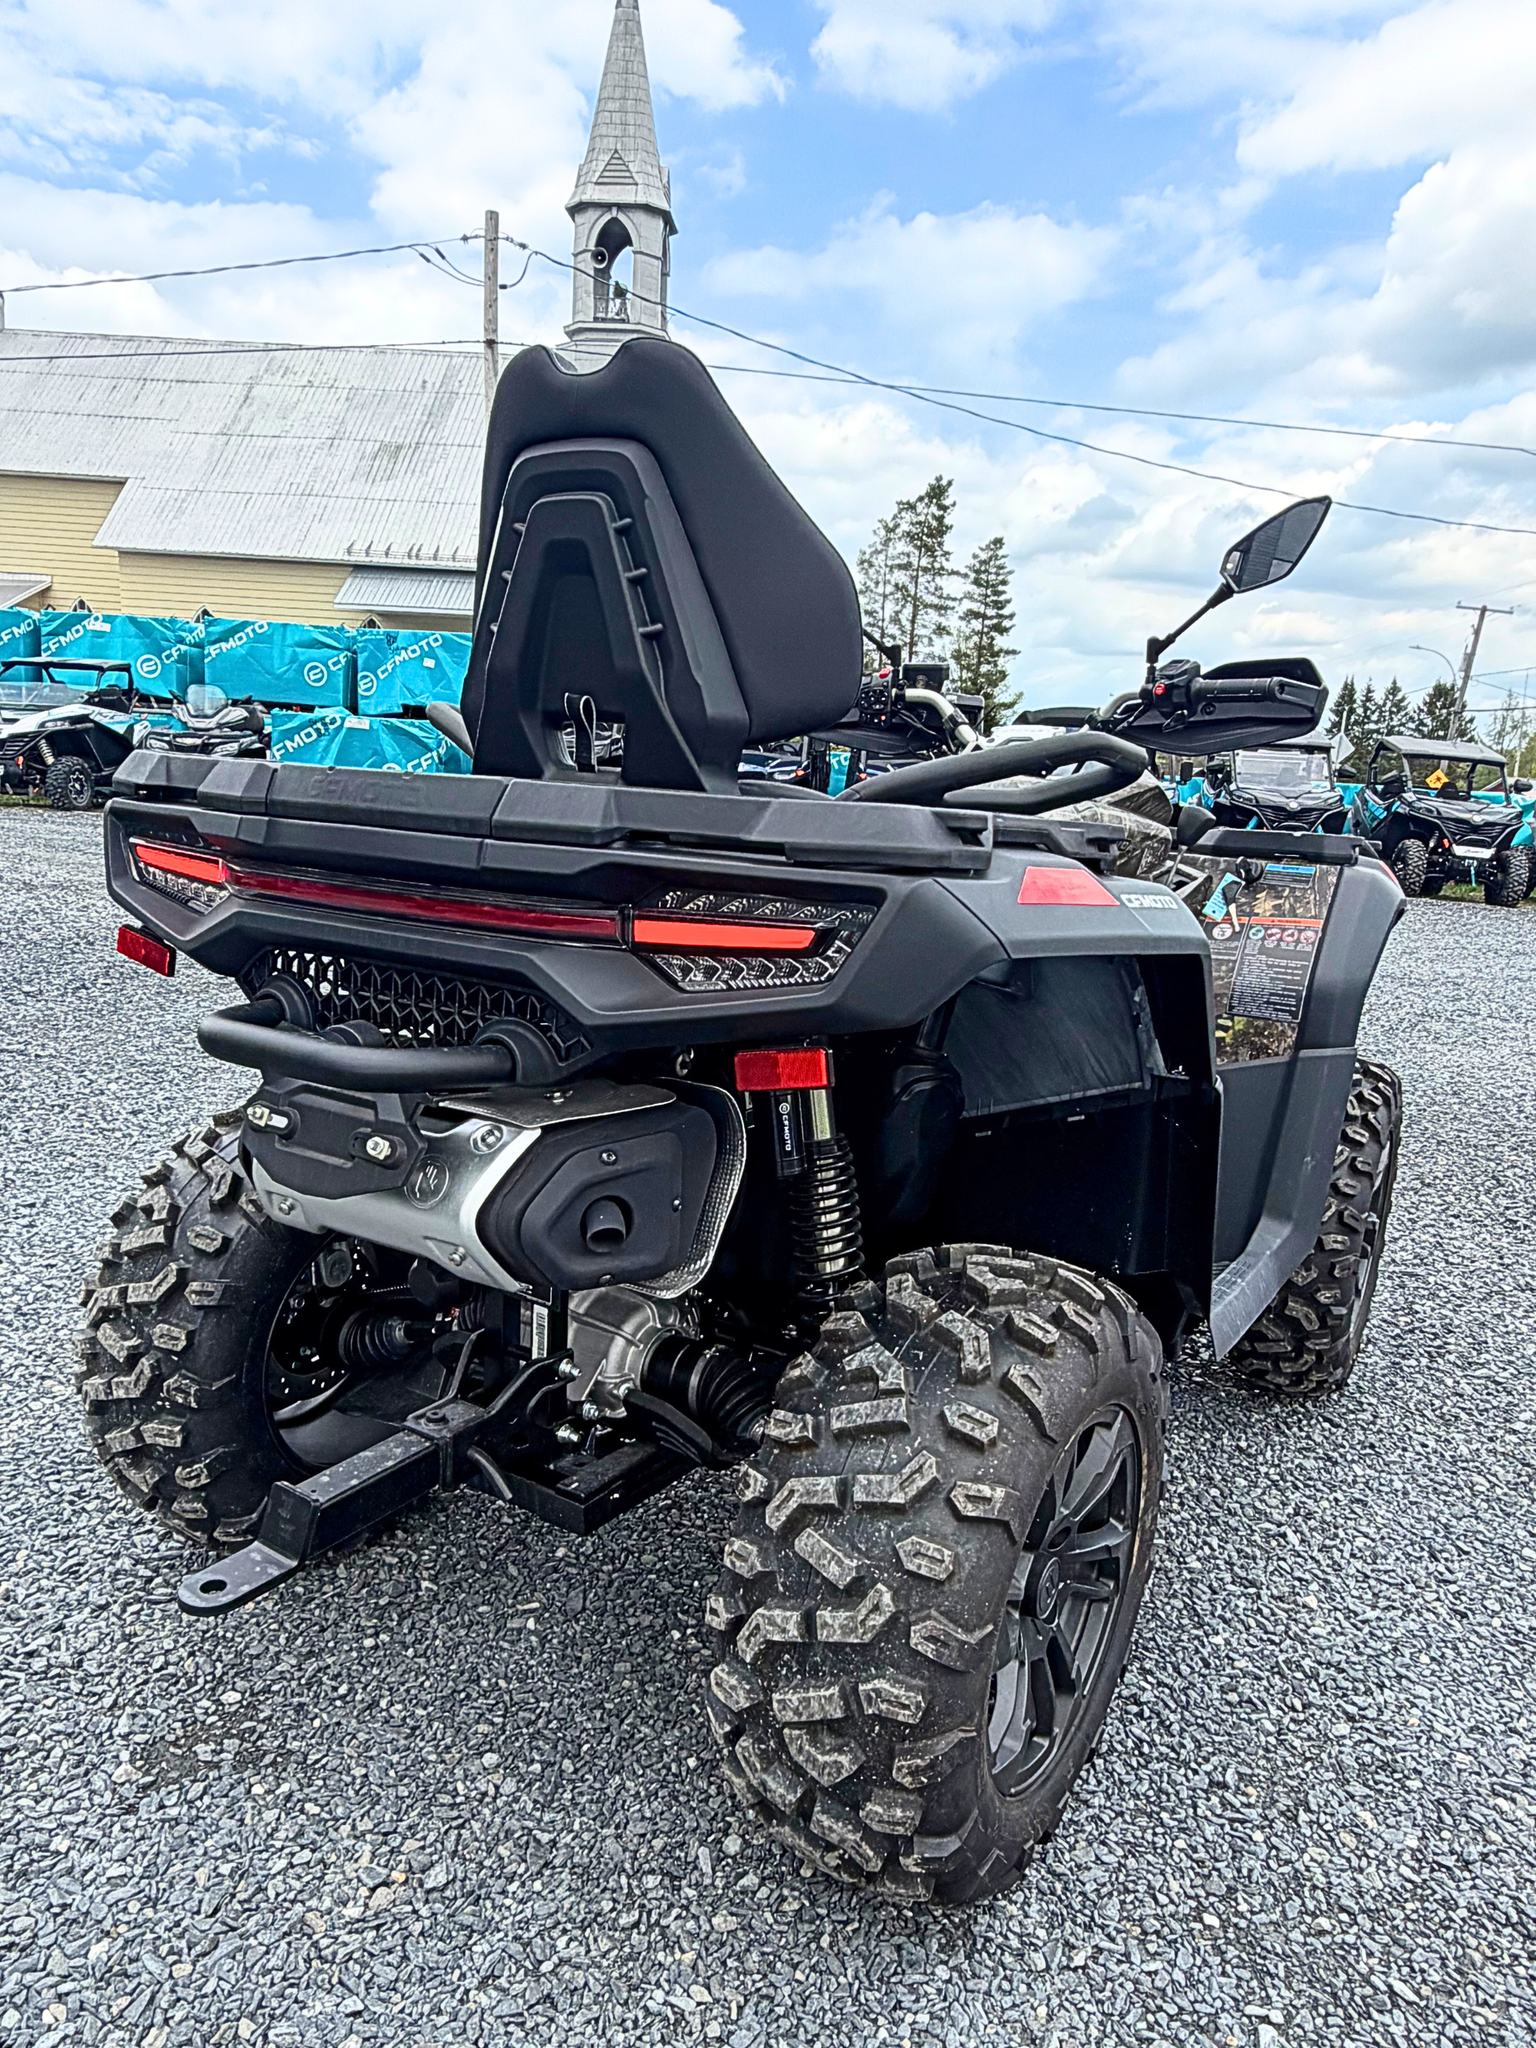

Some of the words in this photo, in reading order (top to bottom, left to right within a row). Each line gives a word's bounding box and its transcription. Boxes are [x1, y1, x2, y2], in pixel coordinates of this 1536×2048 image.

[204, 620, 269, 663] CFMOTO
[376, 633, 443, 680] CFMOTO
[272, 714, 342, 760] FMOTO
[1120, 894, 1179, 909] CFMOTO
[782, 1115, 792, 1151] CFMOTO
